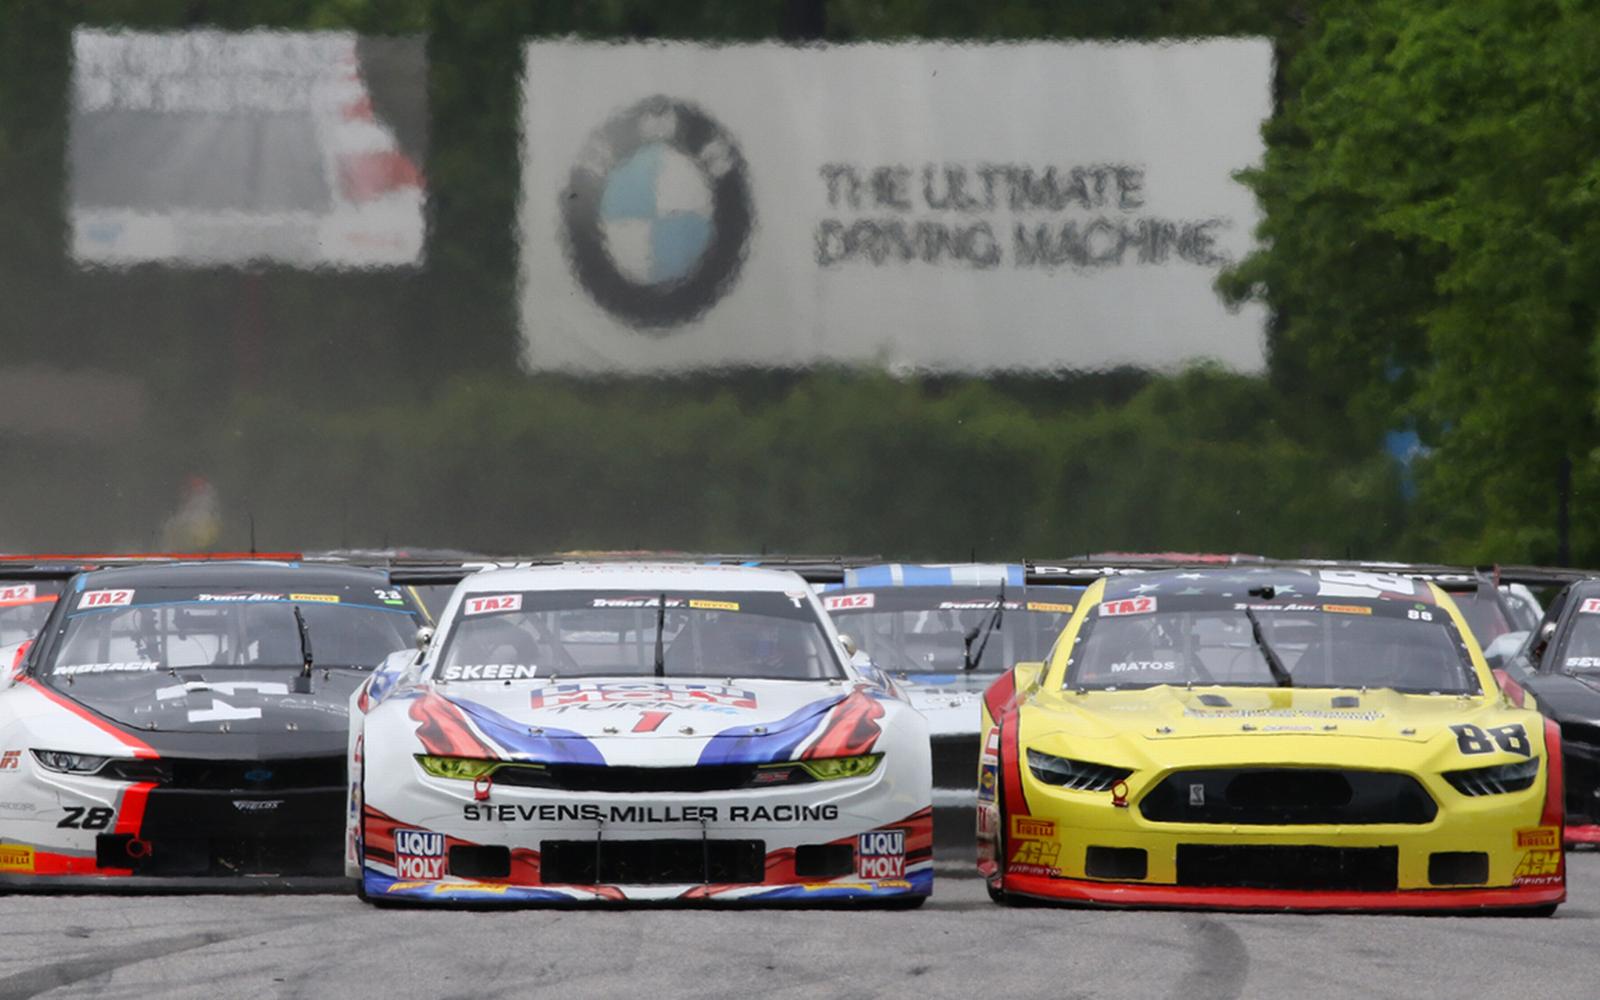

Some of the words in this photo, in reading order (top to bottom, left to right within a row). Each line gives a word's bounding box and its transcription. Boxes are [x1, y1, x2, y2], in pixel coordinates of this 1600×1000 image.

[818, 163, 912, 212] THE
[921, 163, 1146, 212] ULTIMATE
[814, 218, 1002, 269] DRIVING
[1012, 217, 1232, 270] MACHINE
[0, 588, 29, 600] A2
[87, 592, 129, 606] TA2
[832, 596, 869, 609] TA2
[471, 597, 515, 612] TA2
[1104, 599, 1151, 614] TA2
[444, 664, 537, 680] SKEEN
[1111, 661, 1175, 672] MATOS
[631, 710, 672, 733] 1
[1449, 723, 1531, 758] 88
[729, 804, 839, 822] RACING
[396, 833, 444, 856] LIQUI
[860, 832, 904, 855] LIQUI
[397, 857, 443, 880] MOLY
[861, 857, 904, 879] MOLY
